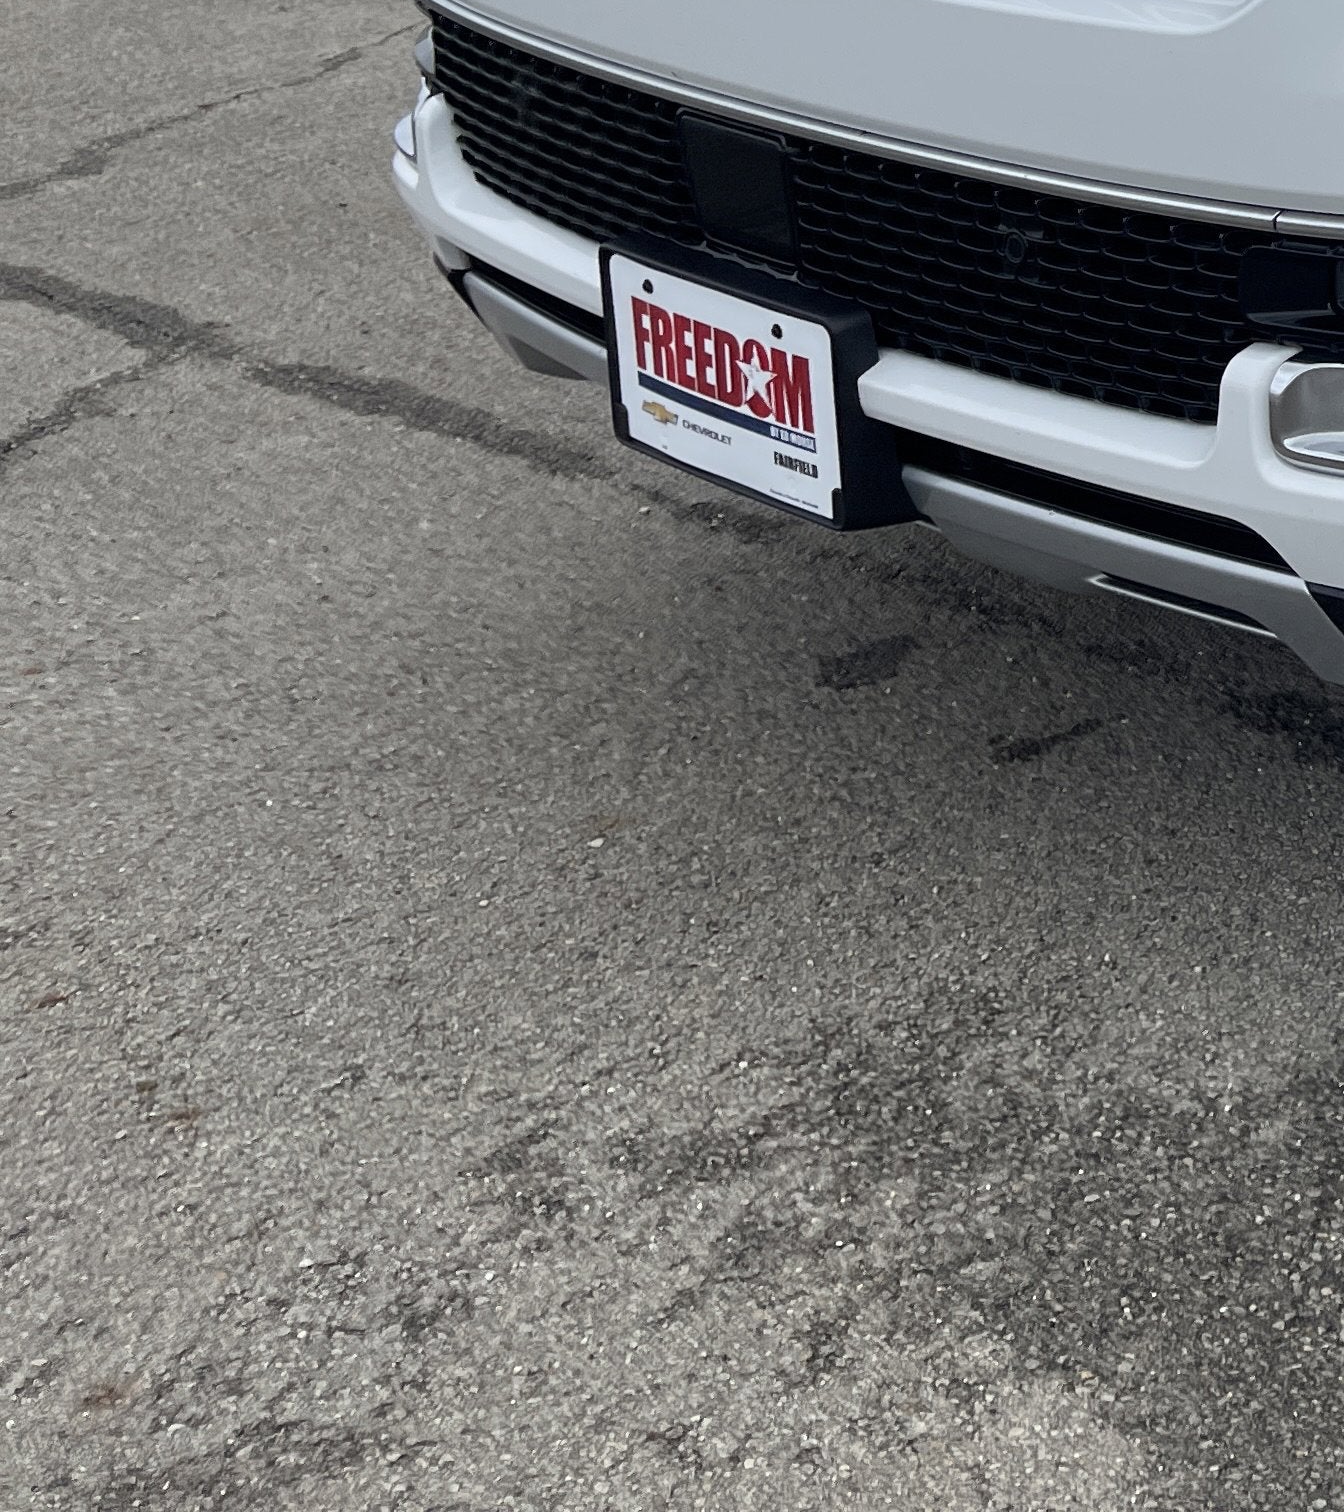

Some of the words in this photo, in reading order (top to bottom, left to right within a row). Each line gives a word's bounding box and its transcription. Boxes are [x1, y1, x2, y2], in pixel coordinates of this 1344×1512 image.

[631, 295, 815, 434] FREEDOM
[681, 419, 732, 445] CHEVROLET
[773, 450, 819, 479] FAIRFIELD
